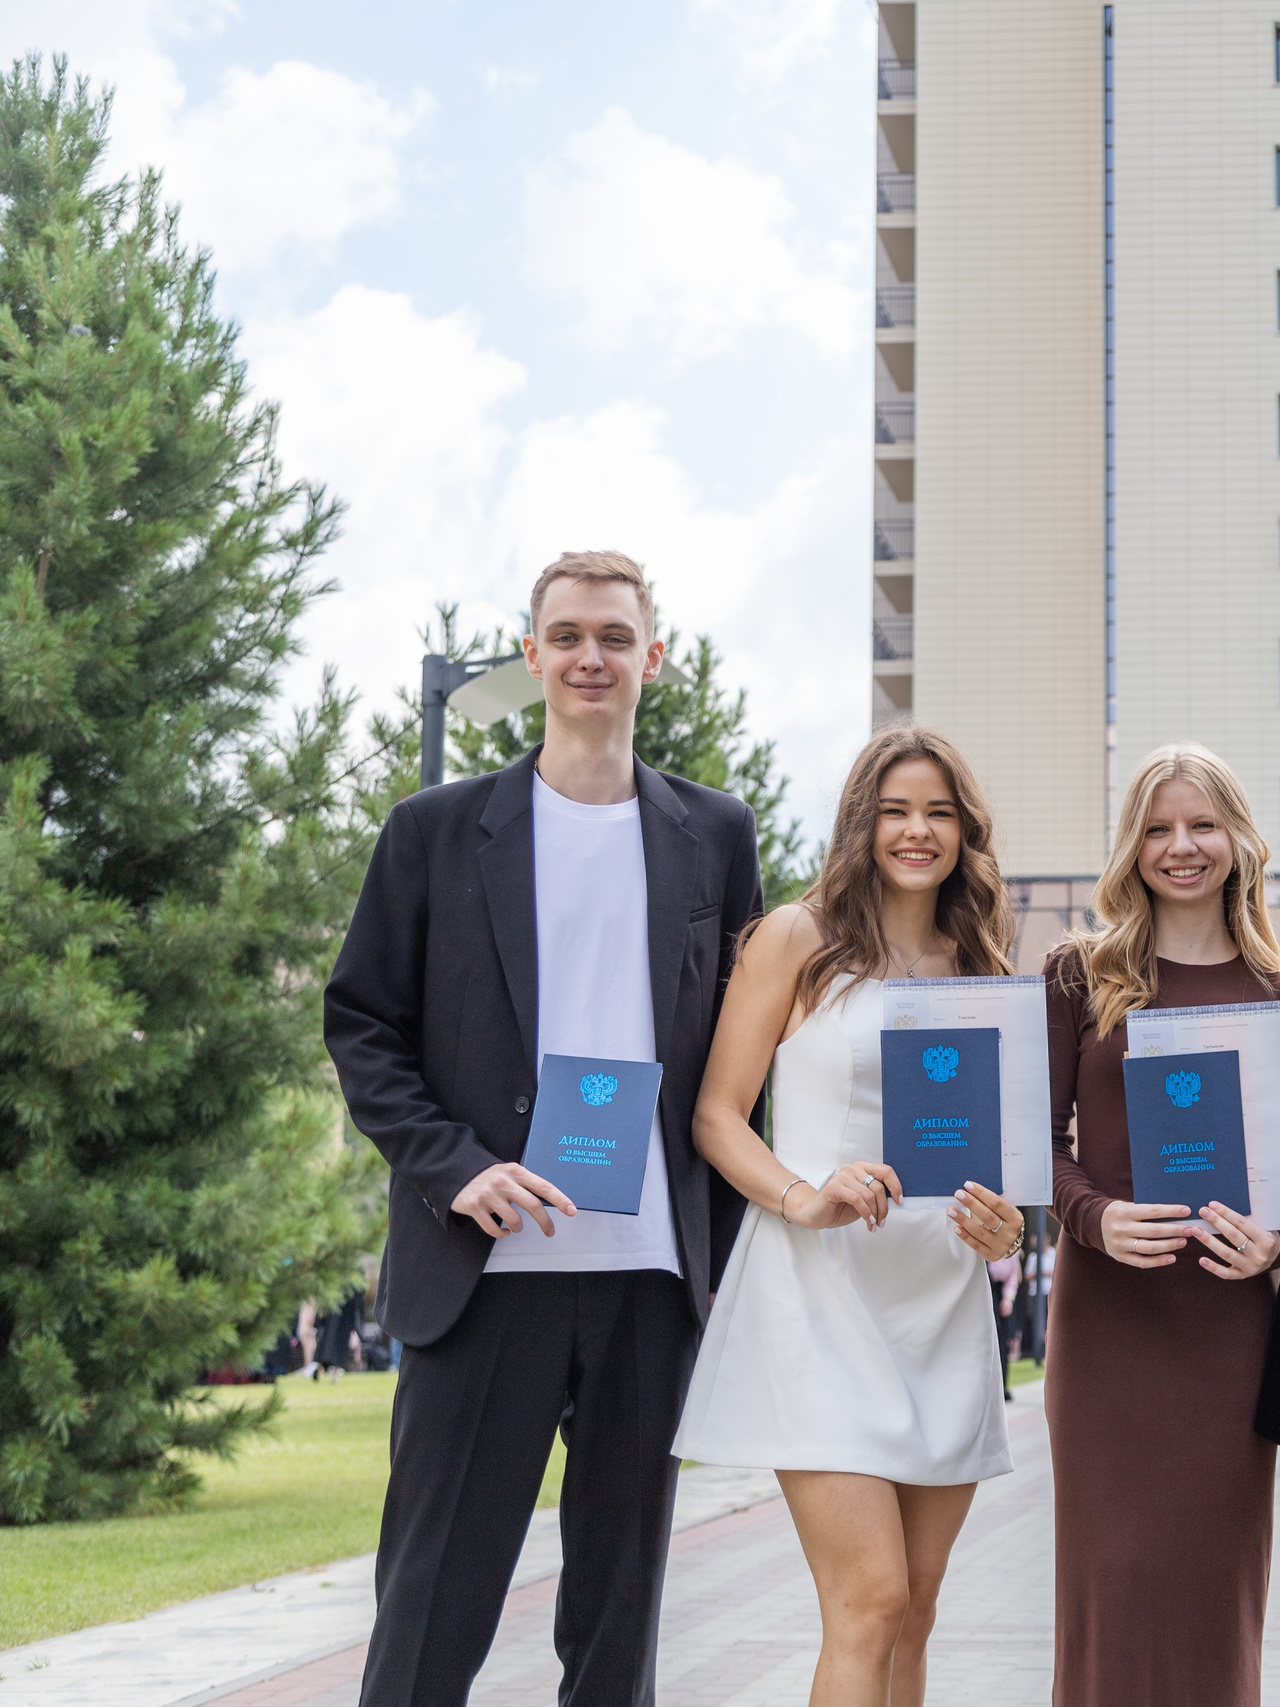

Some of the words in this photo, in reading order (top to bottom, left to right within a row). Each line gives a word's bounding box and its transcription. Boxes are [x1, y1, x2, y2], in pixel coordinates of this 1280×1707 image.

[912, 1117, 969, 1129] ДИПЛОМ
[558, 1135, 616, 1149] ДИПЛОМ
[572, 1149, 606, 1158] ВЫСШЕМ
[1160, 1141, 1215, 1156] ДИПЛОМ
[558, 1155, 611, 1165] ОБРАЗОВАНИИ
[1175, 1156, 1207, 1164] ВЫСШЕМ
[1163, 1164, 1215, 1173] ОБРАЗОВАНИИ
